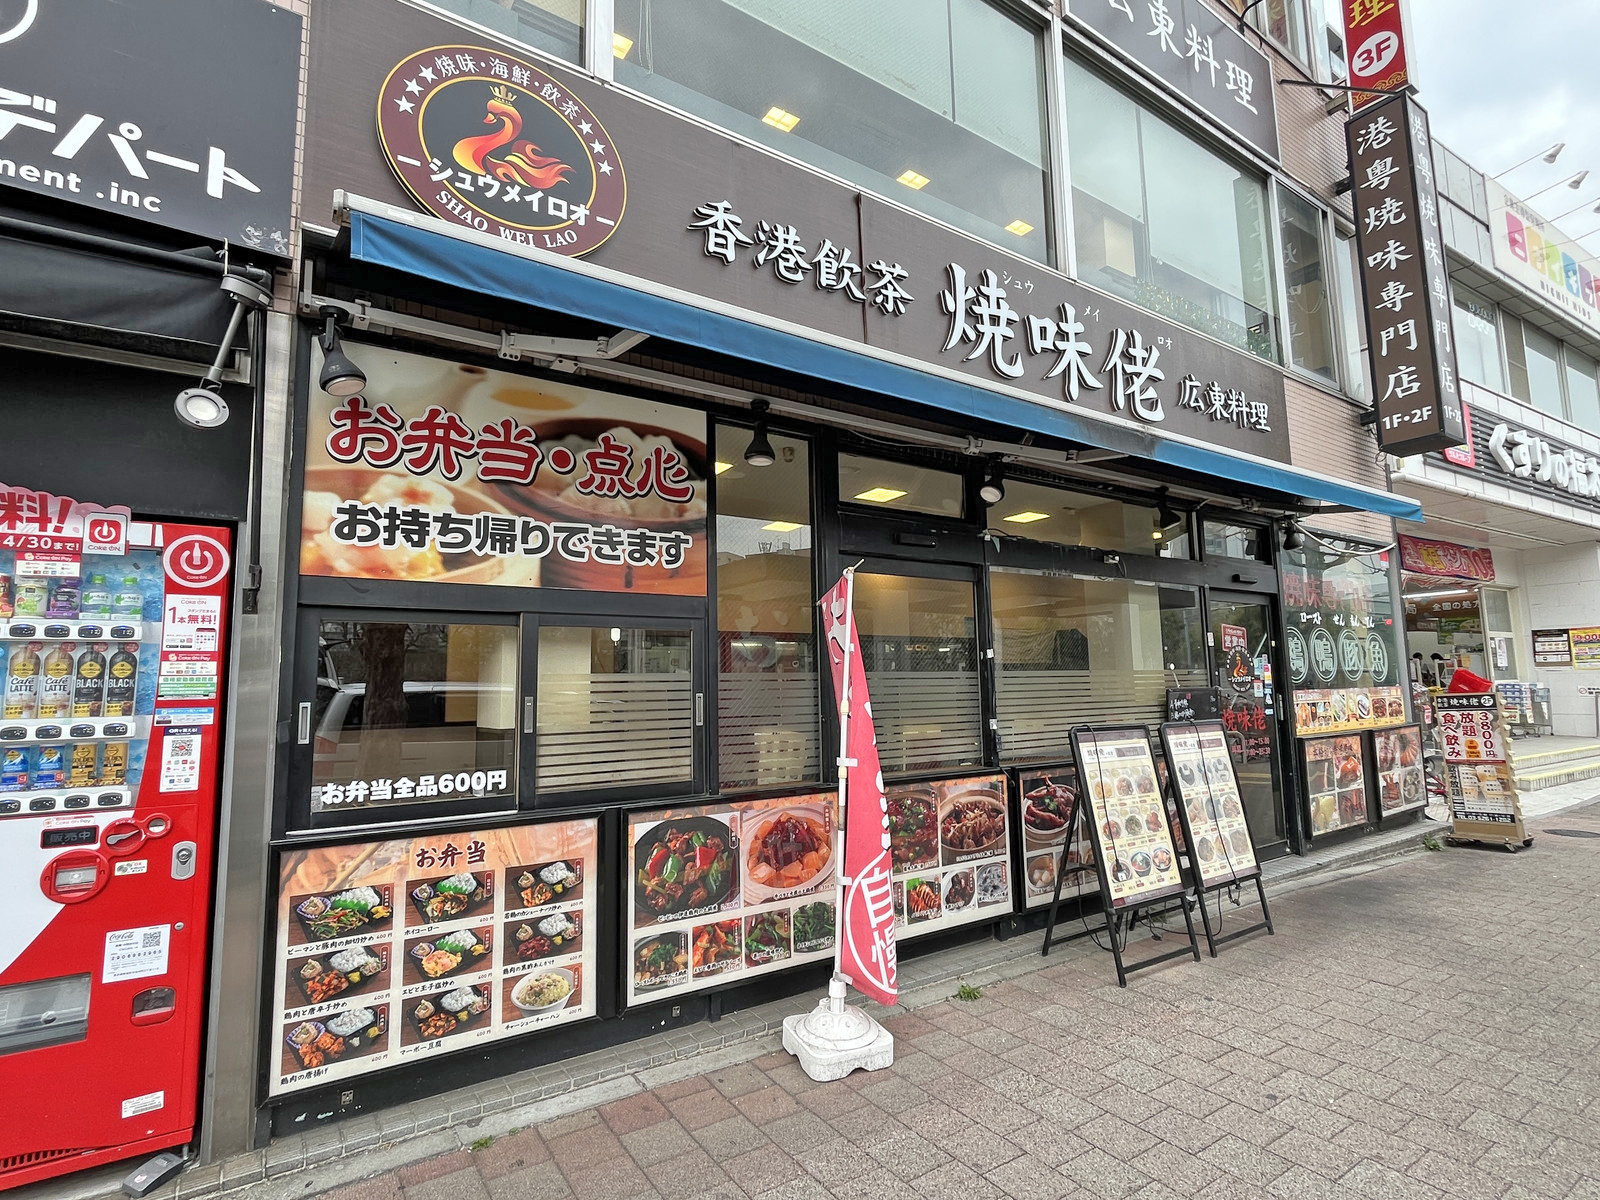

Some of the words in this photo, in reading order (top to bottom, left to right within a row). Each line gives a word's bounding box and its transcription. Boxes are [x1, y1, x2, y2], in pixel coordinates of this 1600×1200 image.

[1356, 36, 1392, 73] 3F
[436, 190, 488, 232] SHAO
[499, 226, 536, 248] WEI
[542, 229, 578, 248] LAO
[687, 199, 914, 316] 香港飲茶
[1002, 270, 1035, 294] シュウ
[1083, 305, 1100, 322] メイ
[940, 262, 1167, 424] 焼味佬
[1178, 373, 1272, 432] 広東料理
[326, 395, 696, 502] お弁当・点心
[331, 500, 692, 568] お持ち帰りできます
[76, 678, 104, 688] BLACK
[108, 678, 135, 688] BLACK
[1459, 713, 1477, 737] 放題
[320, 770, 508, 805] お弁当全品600円
[50, 831, 91, 843] 販売中
[416, 840, 487, 868] お弁当
